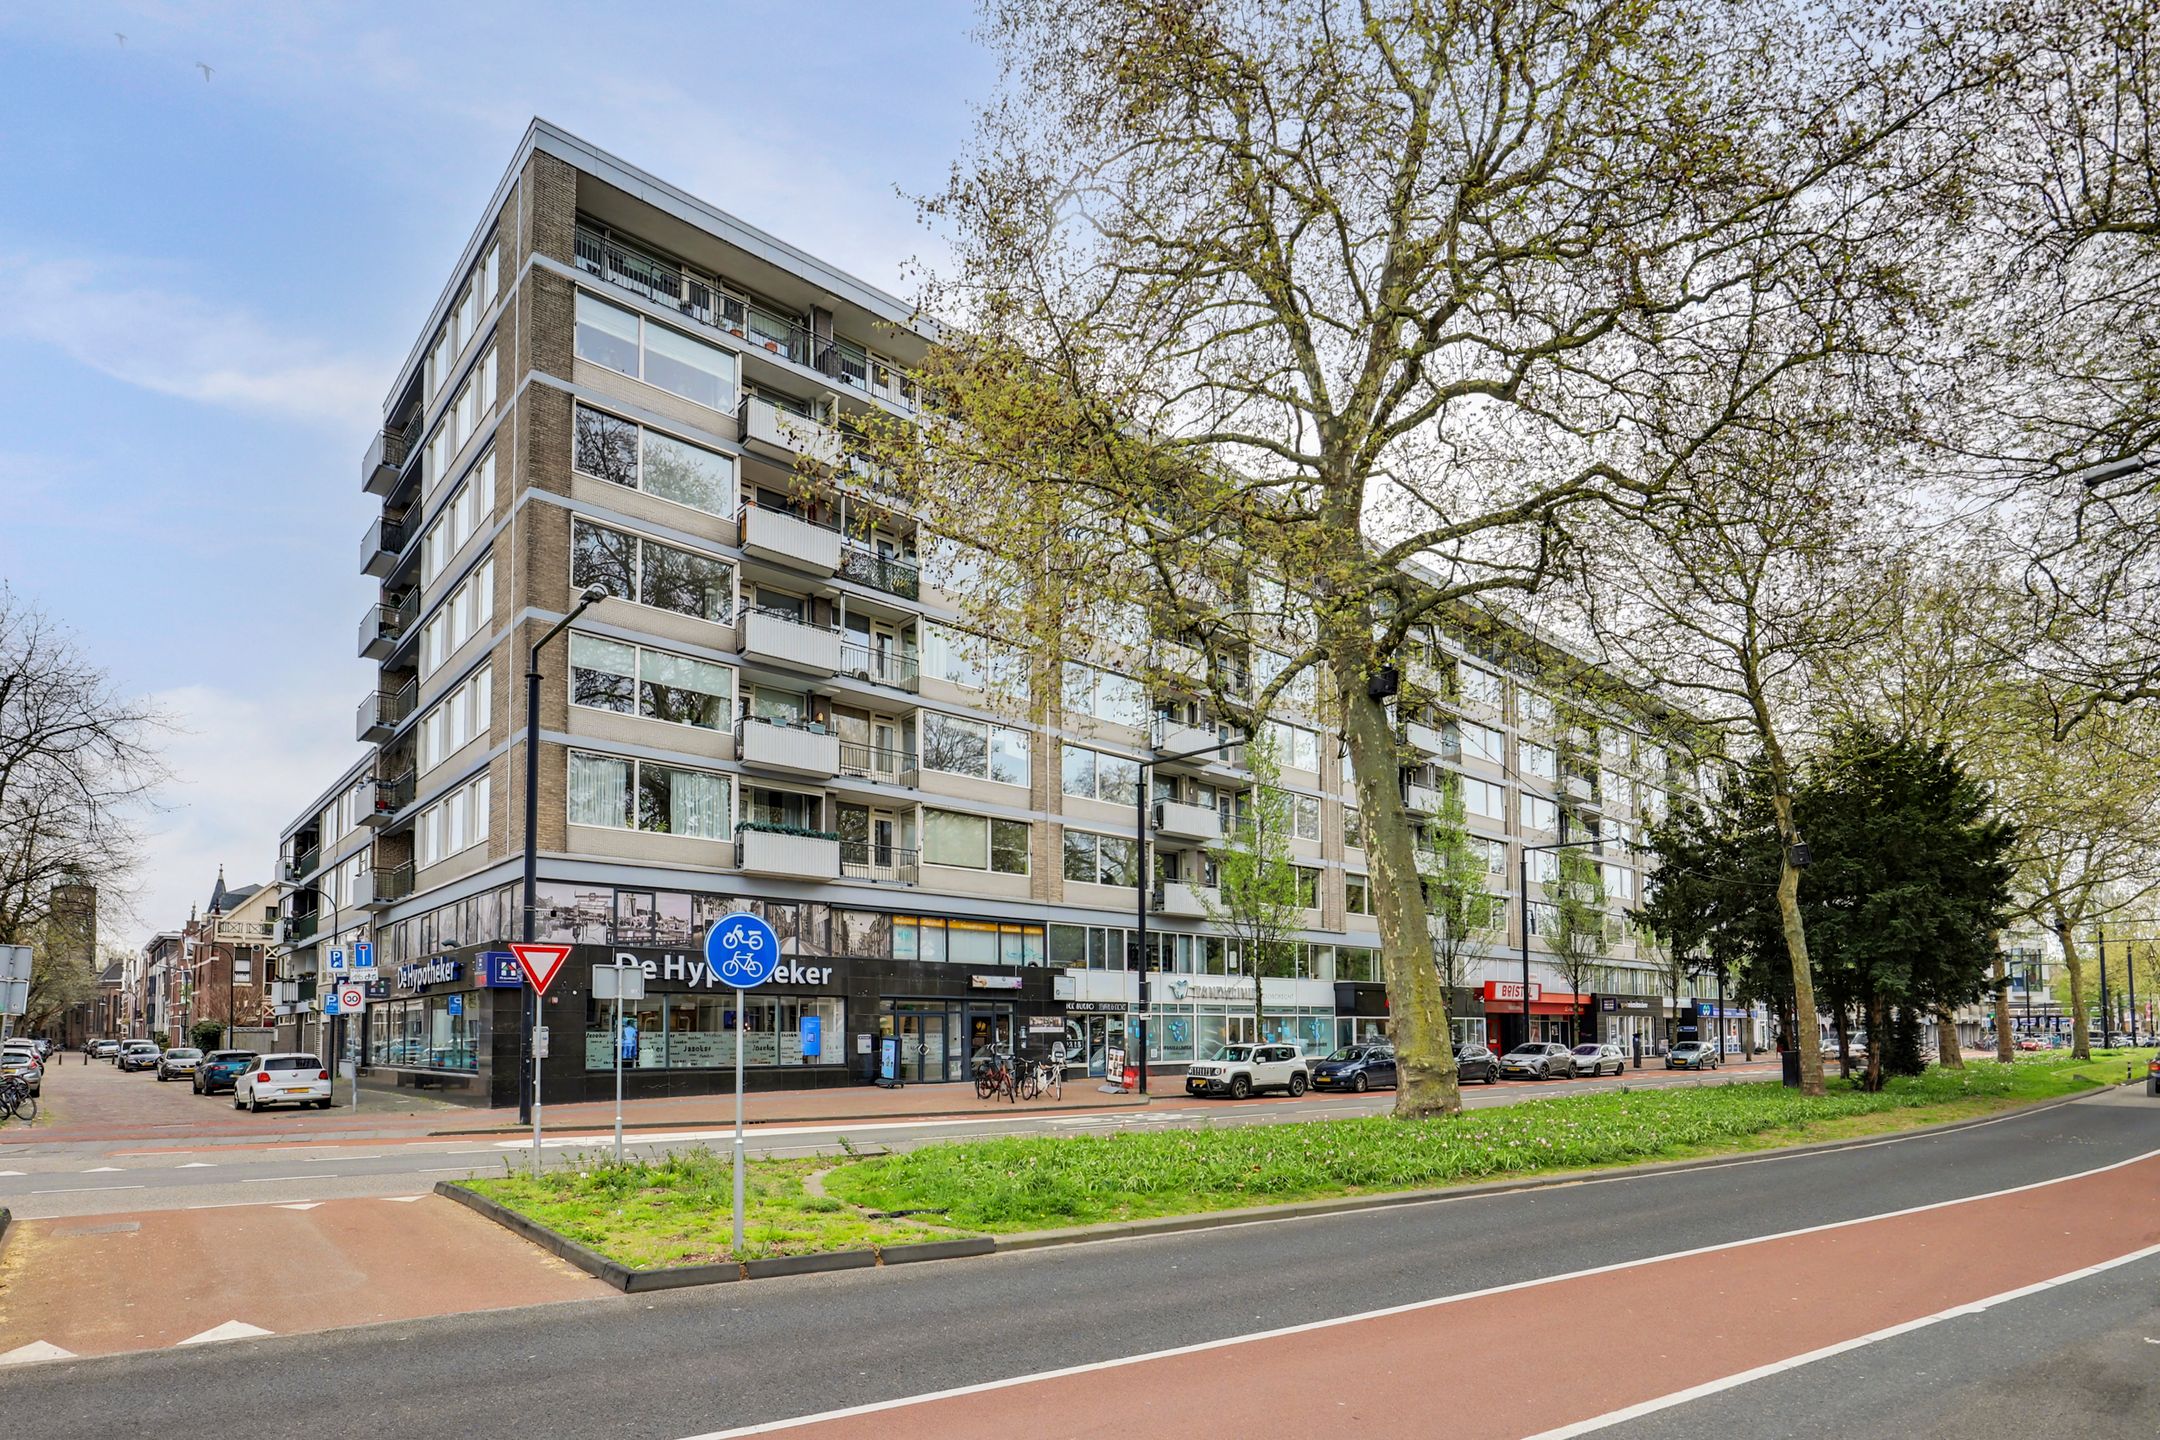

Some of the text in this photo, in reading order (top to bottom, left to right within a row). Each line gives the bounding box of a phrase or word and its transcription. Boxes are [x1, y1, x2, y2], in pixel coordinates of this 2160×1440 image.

[333, 951, 341, 961] P
[407, 956, 455, 993] Hypotheker
[664, 955, 833, 988] Hypeker
[1501, 984, 1533, 998] BRISTL
[346, 995, 358, 1003] 30
